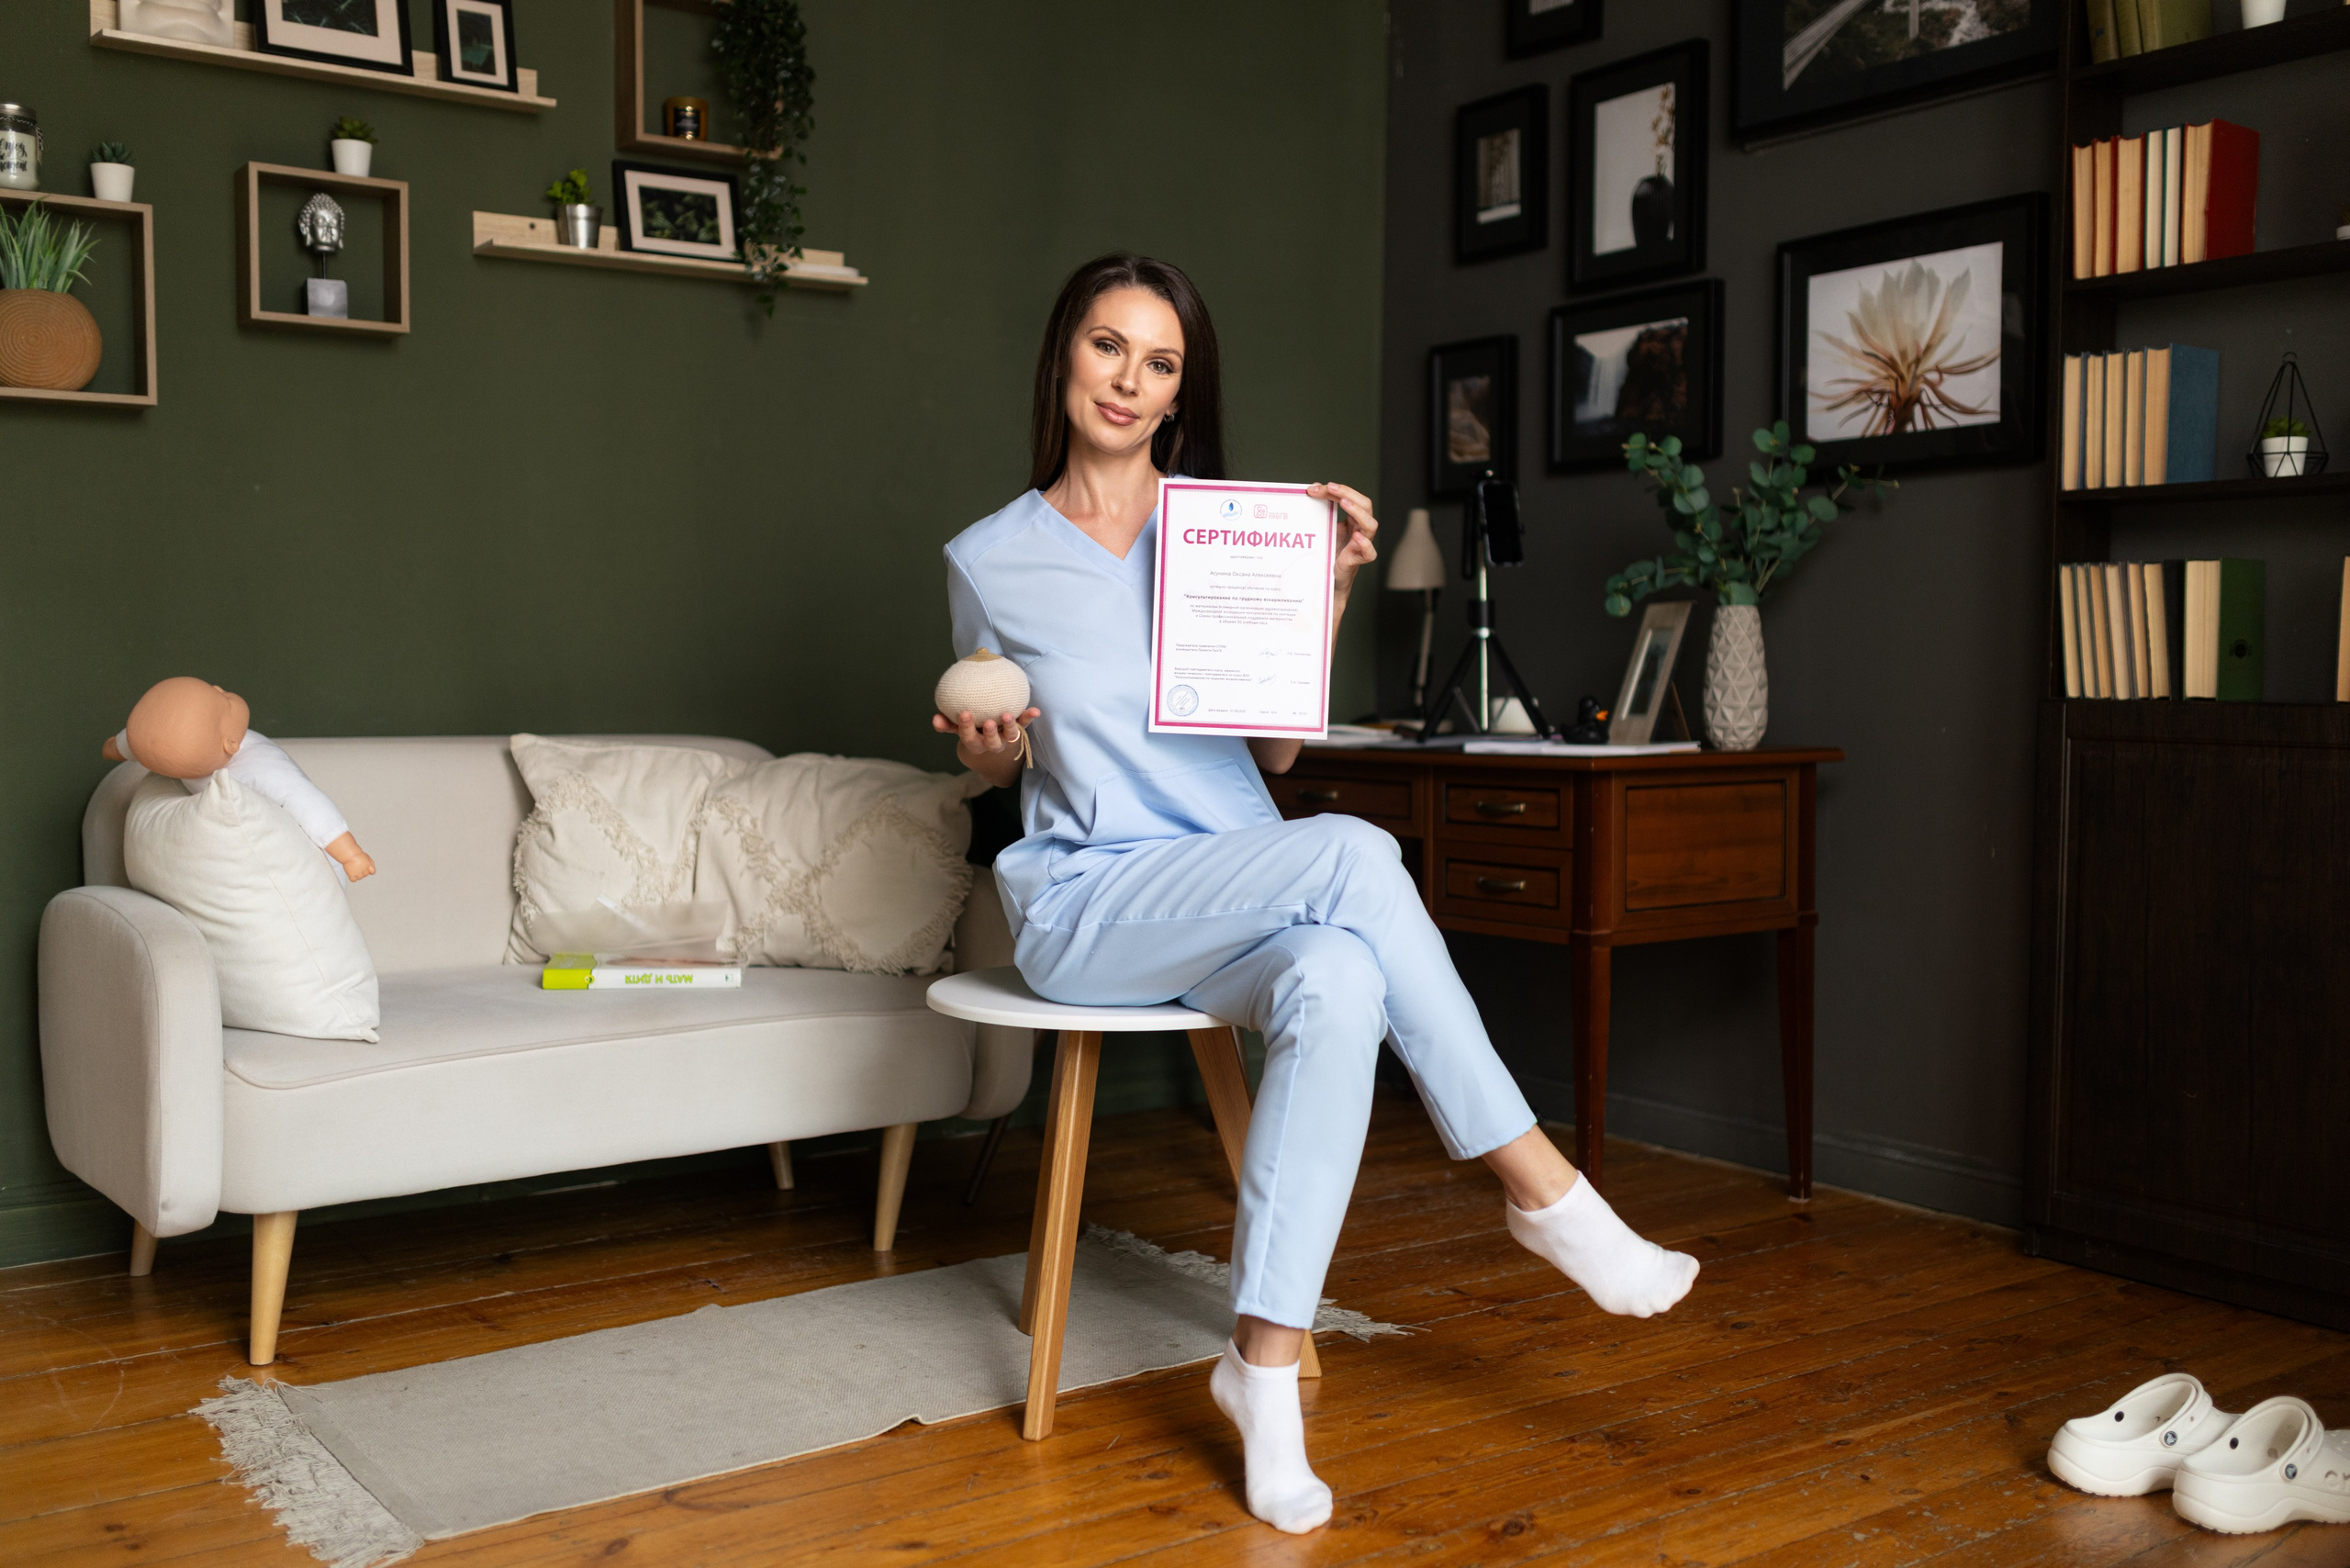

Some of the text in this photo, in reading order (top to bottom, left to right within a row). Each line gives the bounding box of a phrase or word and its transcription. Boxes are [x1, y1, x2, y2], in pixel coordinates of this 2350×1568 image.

[1183, 528, 1316, 549] СЕРТИФИКАТ
[624, 972, 694, 985] МАТЬ И ДИТЯ
